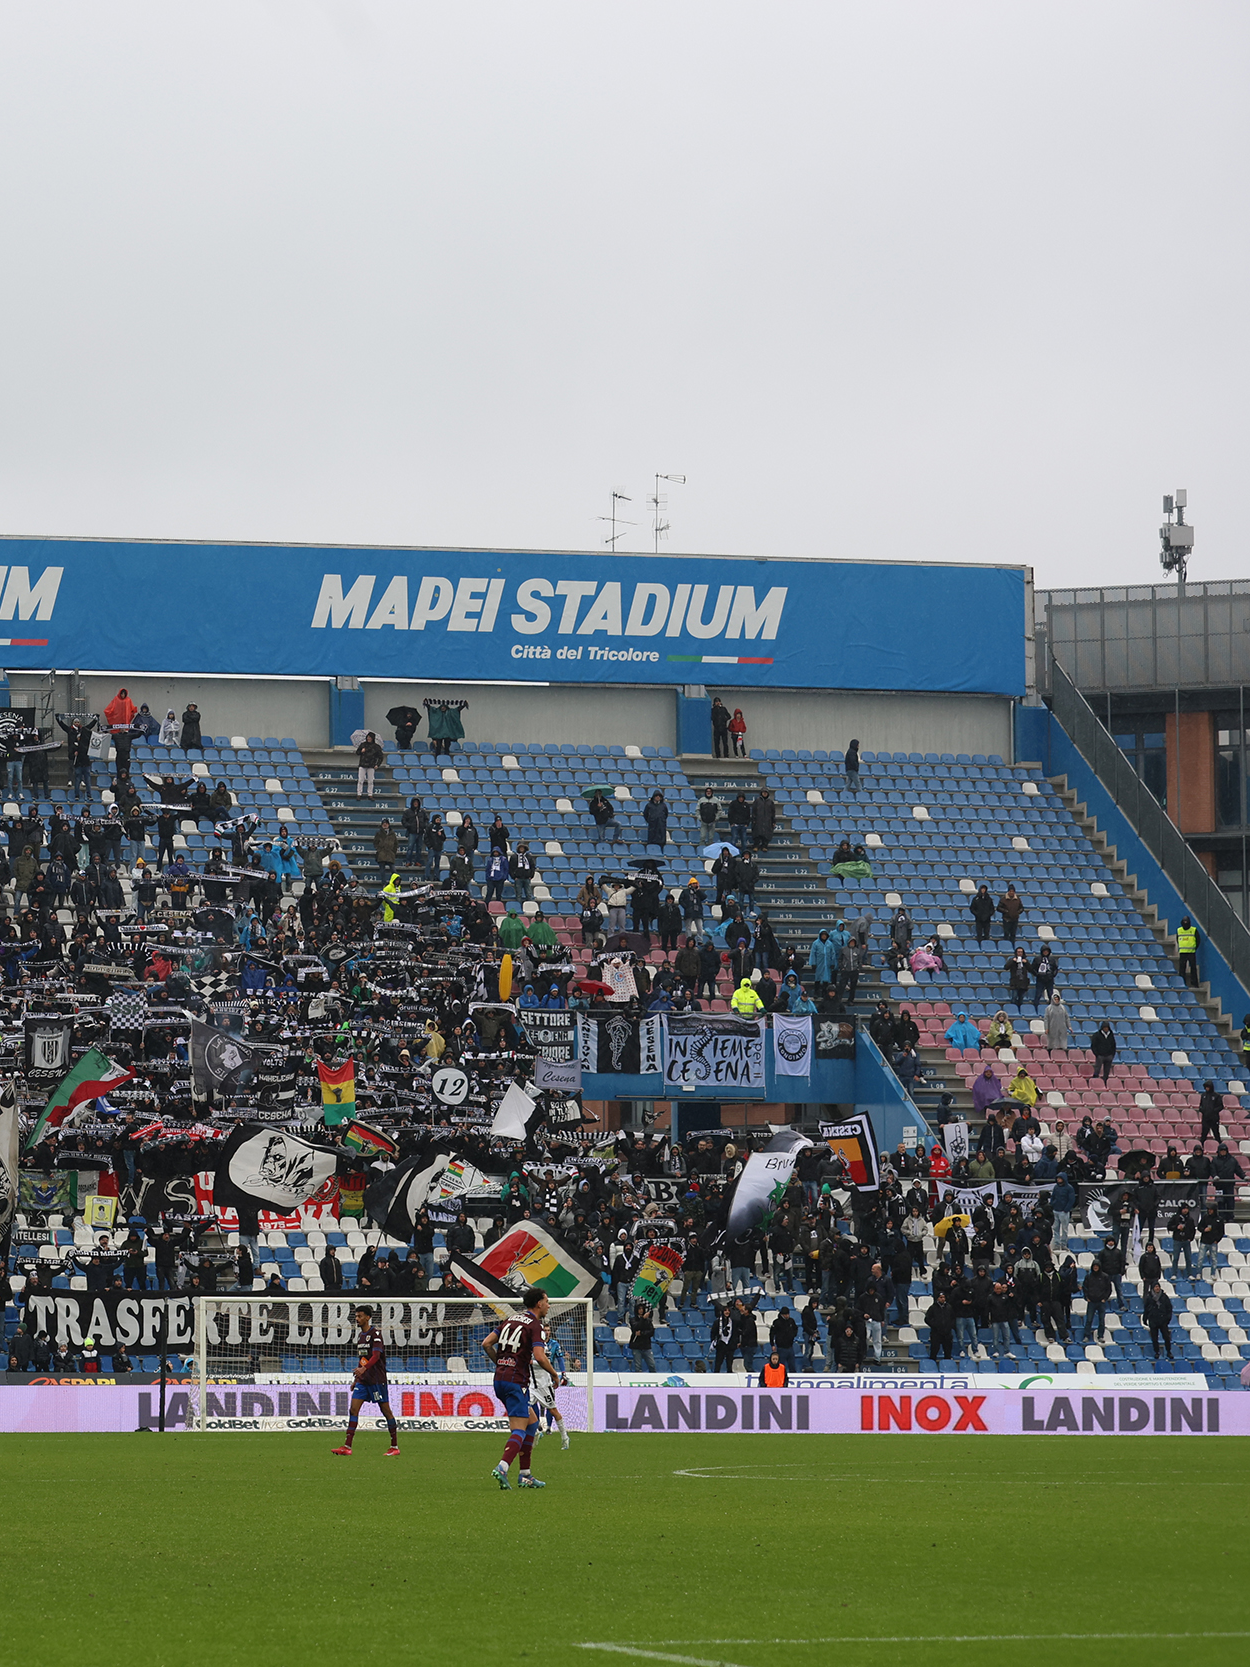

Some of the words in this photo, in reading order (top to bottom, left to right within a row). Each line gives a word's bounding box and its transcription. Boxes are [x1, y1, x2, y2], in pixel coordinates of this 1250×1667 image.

[311, 574, 506, 632] MAPEI
[511, 578, 788, 640] STADIUM
[510, 644, 551, 660] Città
[557, 646, 583, 661] del
[588, 647, 660, 662] Tricolore
[520, 1010, 571, 1027] SETTORE
[645, 1018, 658, 1072] CESENA
[753, 1040, 763, 1067] per
[258, 1072, 296, 1083] NAMELESS
[435, 1078, 466, 1097] 12
[541, 1070, 577, 1085] Cesena
[258, 1108, 292, 1121] CESENA
[28, 1297, 257, 1348] TRASFERTE
[498, 1323, 523, 1353] 44
[138, 1391, 349, 1428] LANDINI
[401, 1391, 508, 1417] INO
[605, 1394, 810, 1430] LANDINI
[860, 1394, 988, 1432] INOX
[1022, 1396, 1220, 1433] LANDINI
